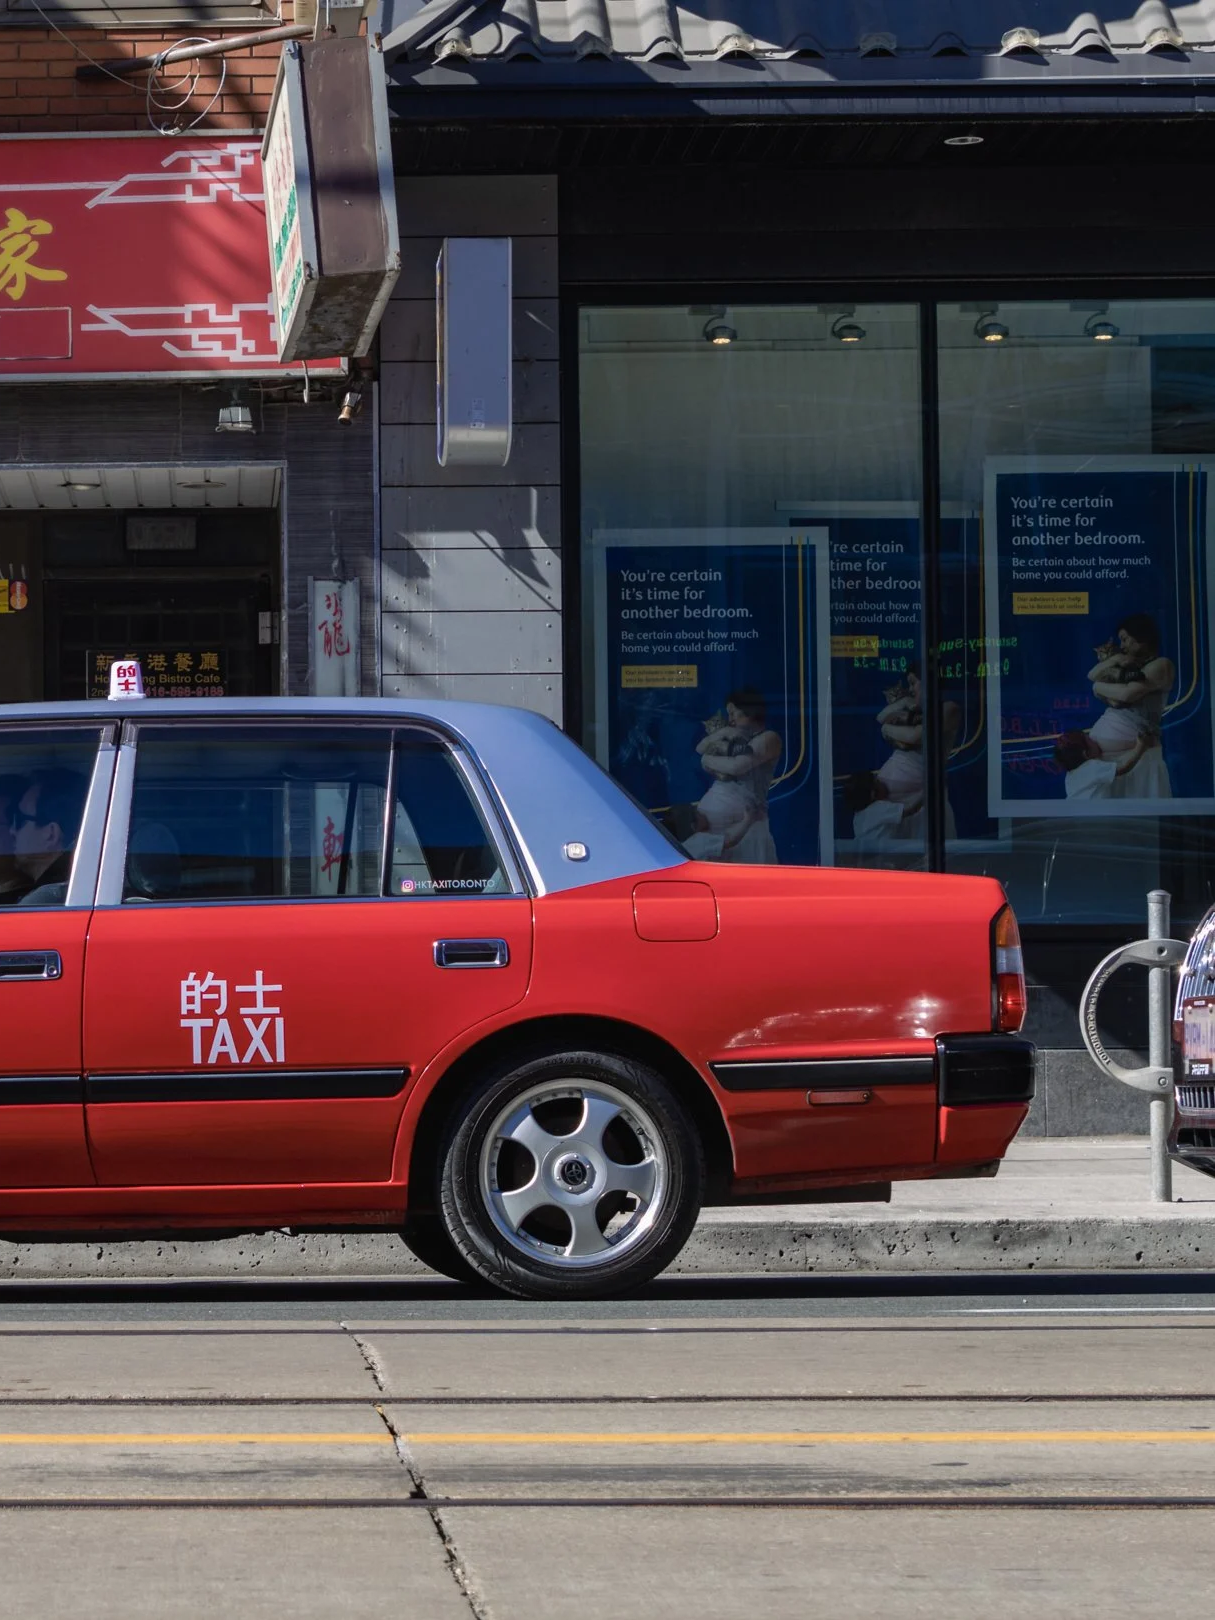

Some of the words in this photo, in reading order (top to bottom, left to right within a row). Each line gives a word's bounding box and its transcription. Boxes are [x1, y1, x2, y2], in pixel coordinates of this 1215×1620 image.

[1011, 496, 1057, 509] You're
[1060, 495, 1114, 508] certain
[1011, 514, 1034, 527] it's
[1038, 514, 1071, 527] time
[1075, 513, 1097, 526] for
[1012, 532, 1071, 546] another
[1074, 531, 1146, 545] bedroom.
[852, 541, 905, 553] certain
[830, 558, 863, 571] time
[866, 558, 887, 571] for
[1012, 557, 1026, 566] Be
[1028, 557, 1064, 566] certain
[1066, 556, 1096, 566] about
[1098, 556, 1120, 566] how
[1122, 555, 1151, 565] much
[621, 569, 666, 582] You're
[669, 568, 722, 581] certain
[1012, 570, 1042, 579] home
[1044, 571, 1062, 582] you
[1065, 569, 1093, 579] could
[1095, 569, 1130, 579] afford.
[831, 576, 862, 590] ther
[621, 588, 644, 600] it's
[647, 588, 681, 600] time
[684, 586, 706, 600] for
[621, 605, 680, 619] another
[683, 604, 753, 618] bedroom.
[831, 602, 855, 610] rtain
[857, 601, 886, 610] about
[889, 600, 910, 610] how
[834, 616, 852, 625] you
[855, 614, 883, 623] could
[621, 631, 634, 640] Be
[636, 631, 673, 640] certain
[675, 629, 705, 639] about
[707, 629, 728, 639] how
[731, 628, 759, 639] much
[621, 643, 650, 653] home
[652, 644, 671, 654] you
[673, 642, 701, 652] could
[704, 642, 738, 652] afford.
[95, 674, 111, 684] Ho
[159, 674, 192, 684] Bistro
[194, 674, 221, 684] Cafe
[117, 665, 136, 692] 的士
[180, 970, 283, 1016] 的士
[180, 1017, 285, 1064] TAXI
